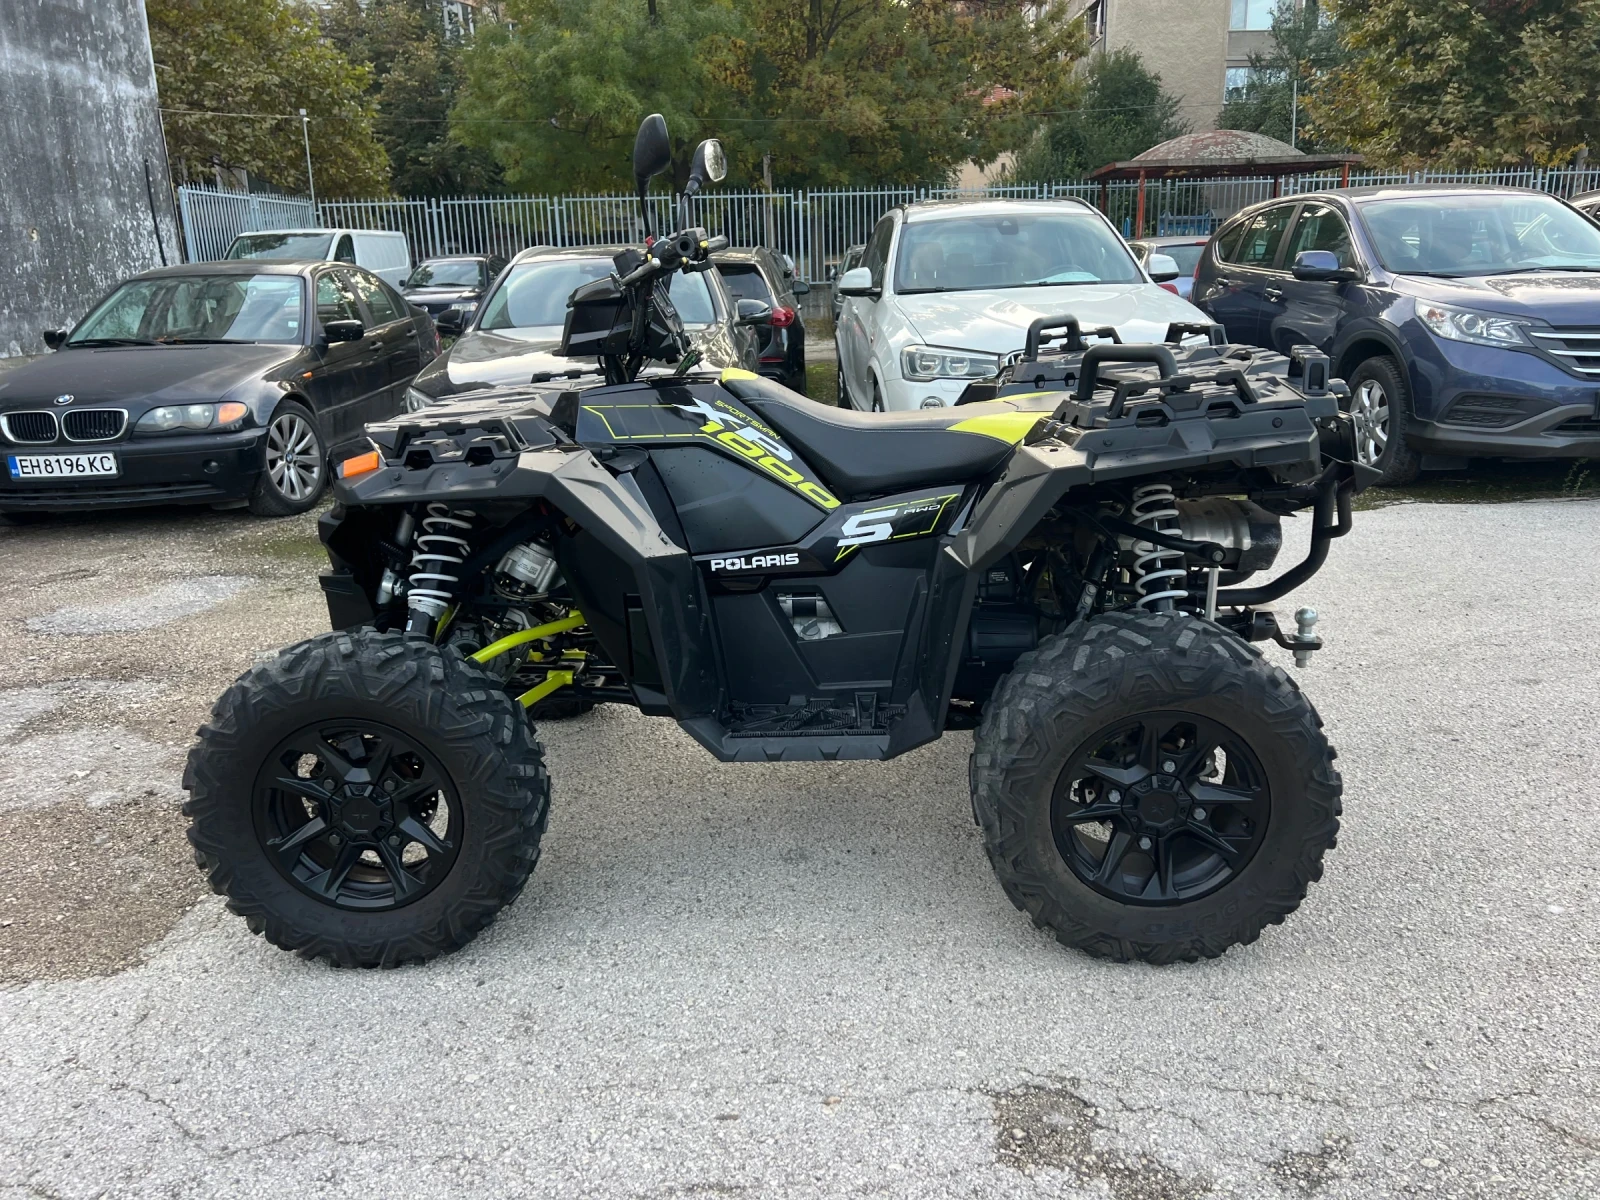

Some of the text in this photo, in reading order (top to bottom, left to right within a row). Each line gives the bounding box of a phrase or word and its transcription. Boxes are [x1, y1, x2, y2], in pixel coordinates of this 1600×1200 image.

[673, 397, 793, 462] XP
[714, 400, 781, 440] SPORTSMAN
[699, 420, 842, 509] 1000
[836, 504, 941, 547] S AWD
[710, 553, 800, 572] POLARIS
